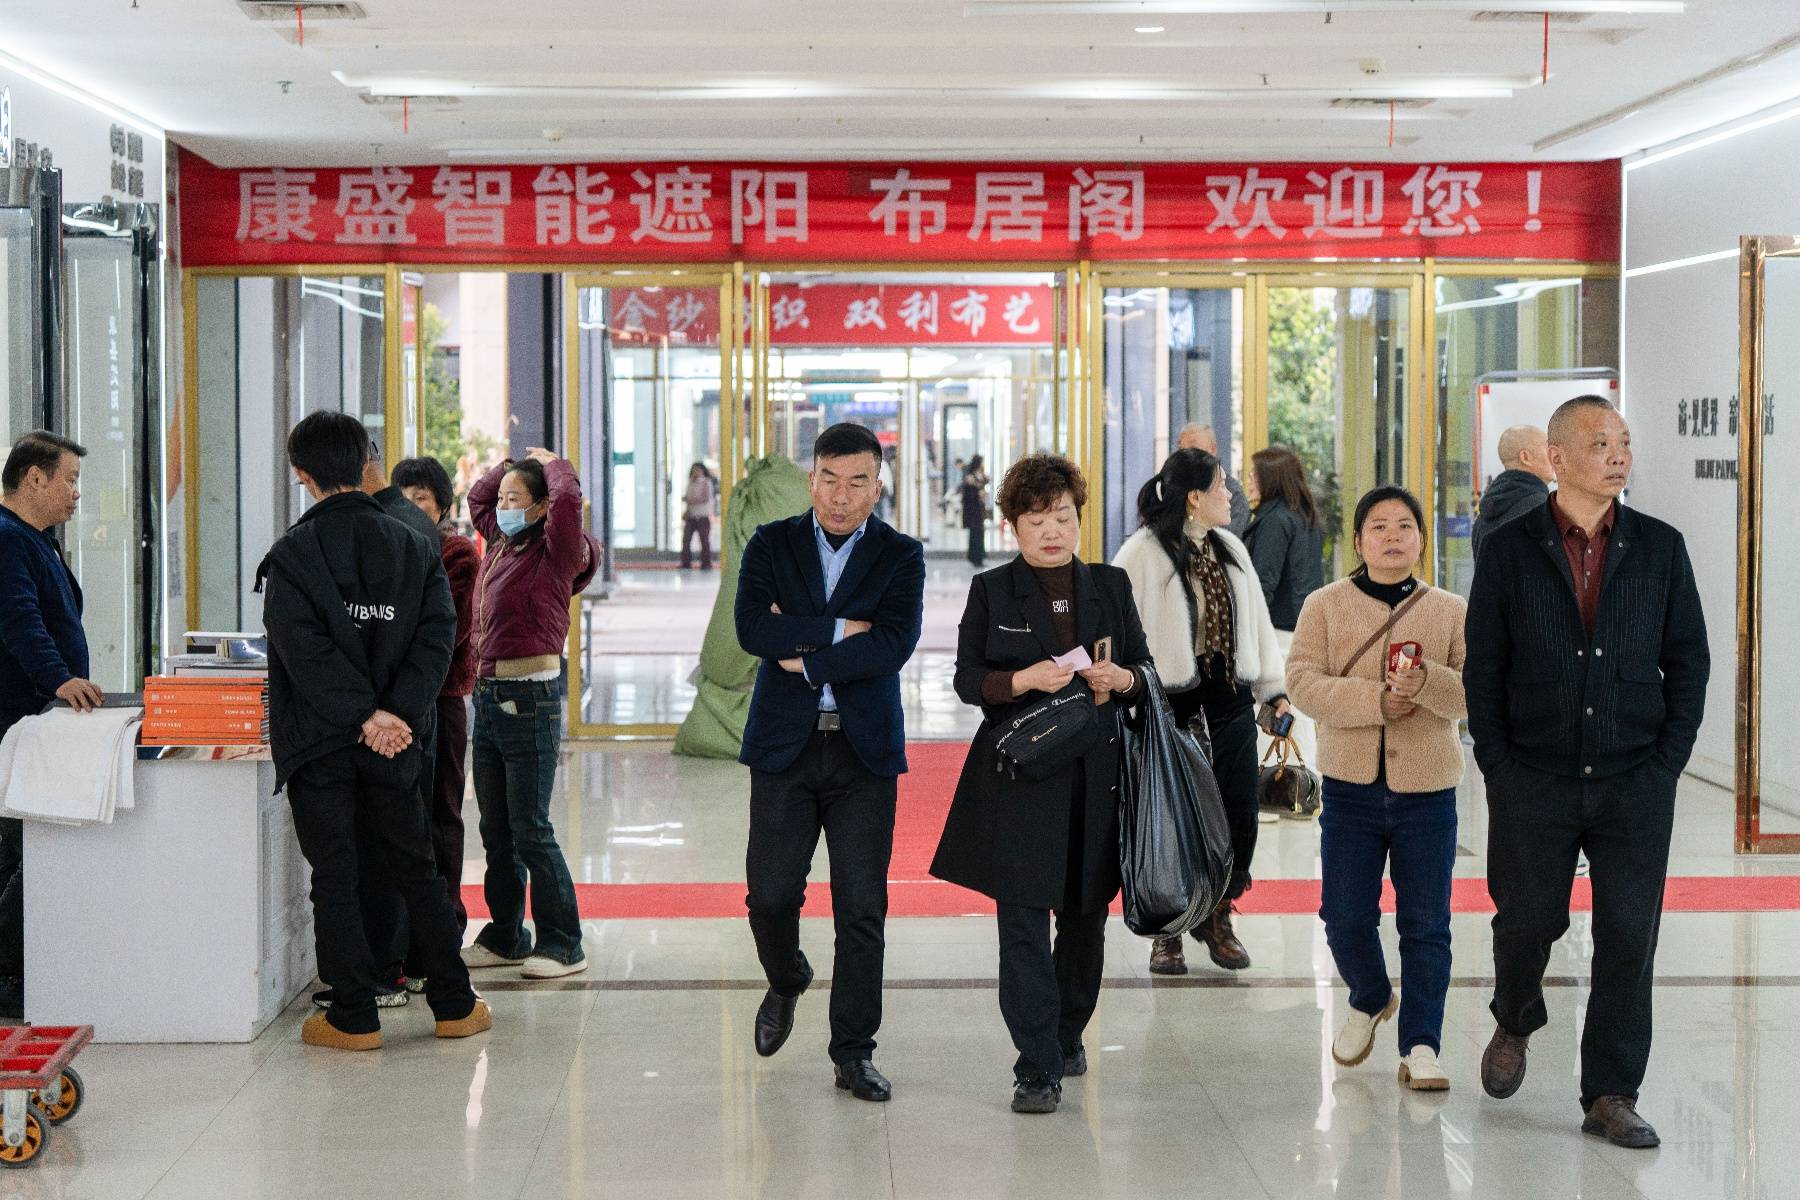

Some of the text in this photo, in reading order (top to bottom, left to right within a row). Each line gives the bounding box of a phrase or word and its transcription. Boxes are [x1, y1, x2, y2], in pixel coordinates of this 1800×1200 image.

[234, 165, 1543, 247] 康盛智能遮阳 布居阁 欢迎您！
[613, 290, 1040, 337] 金纱织 双利布艺
